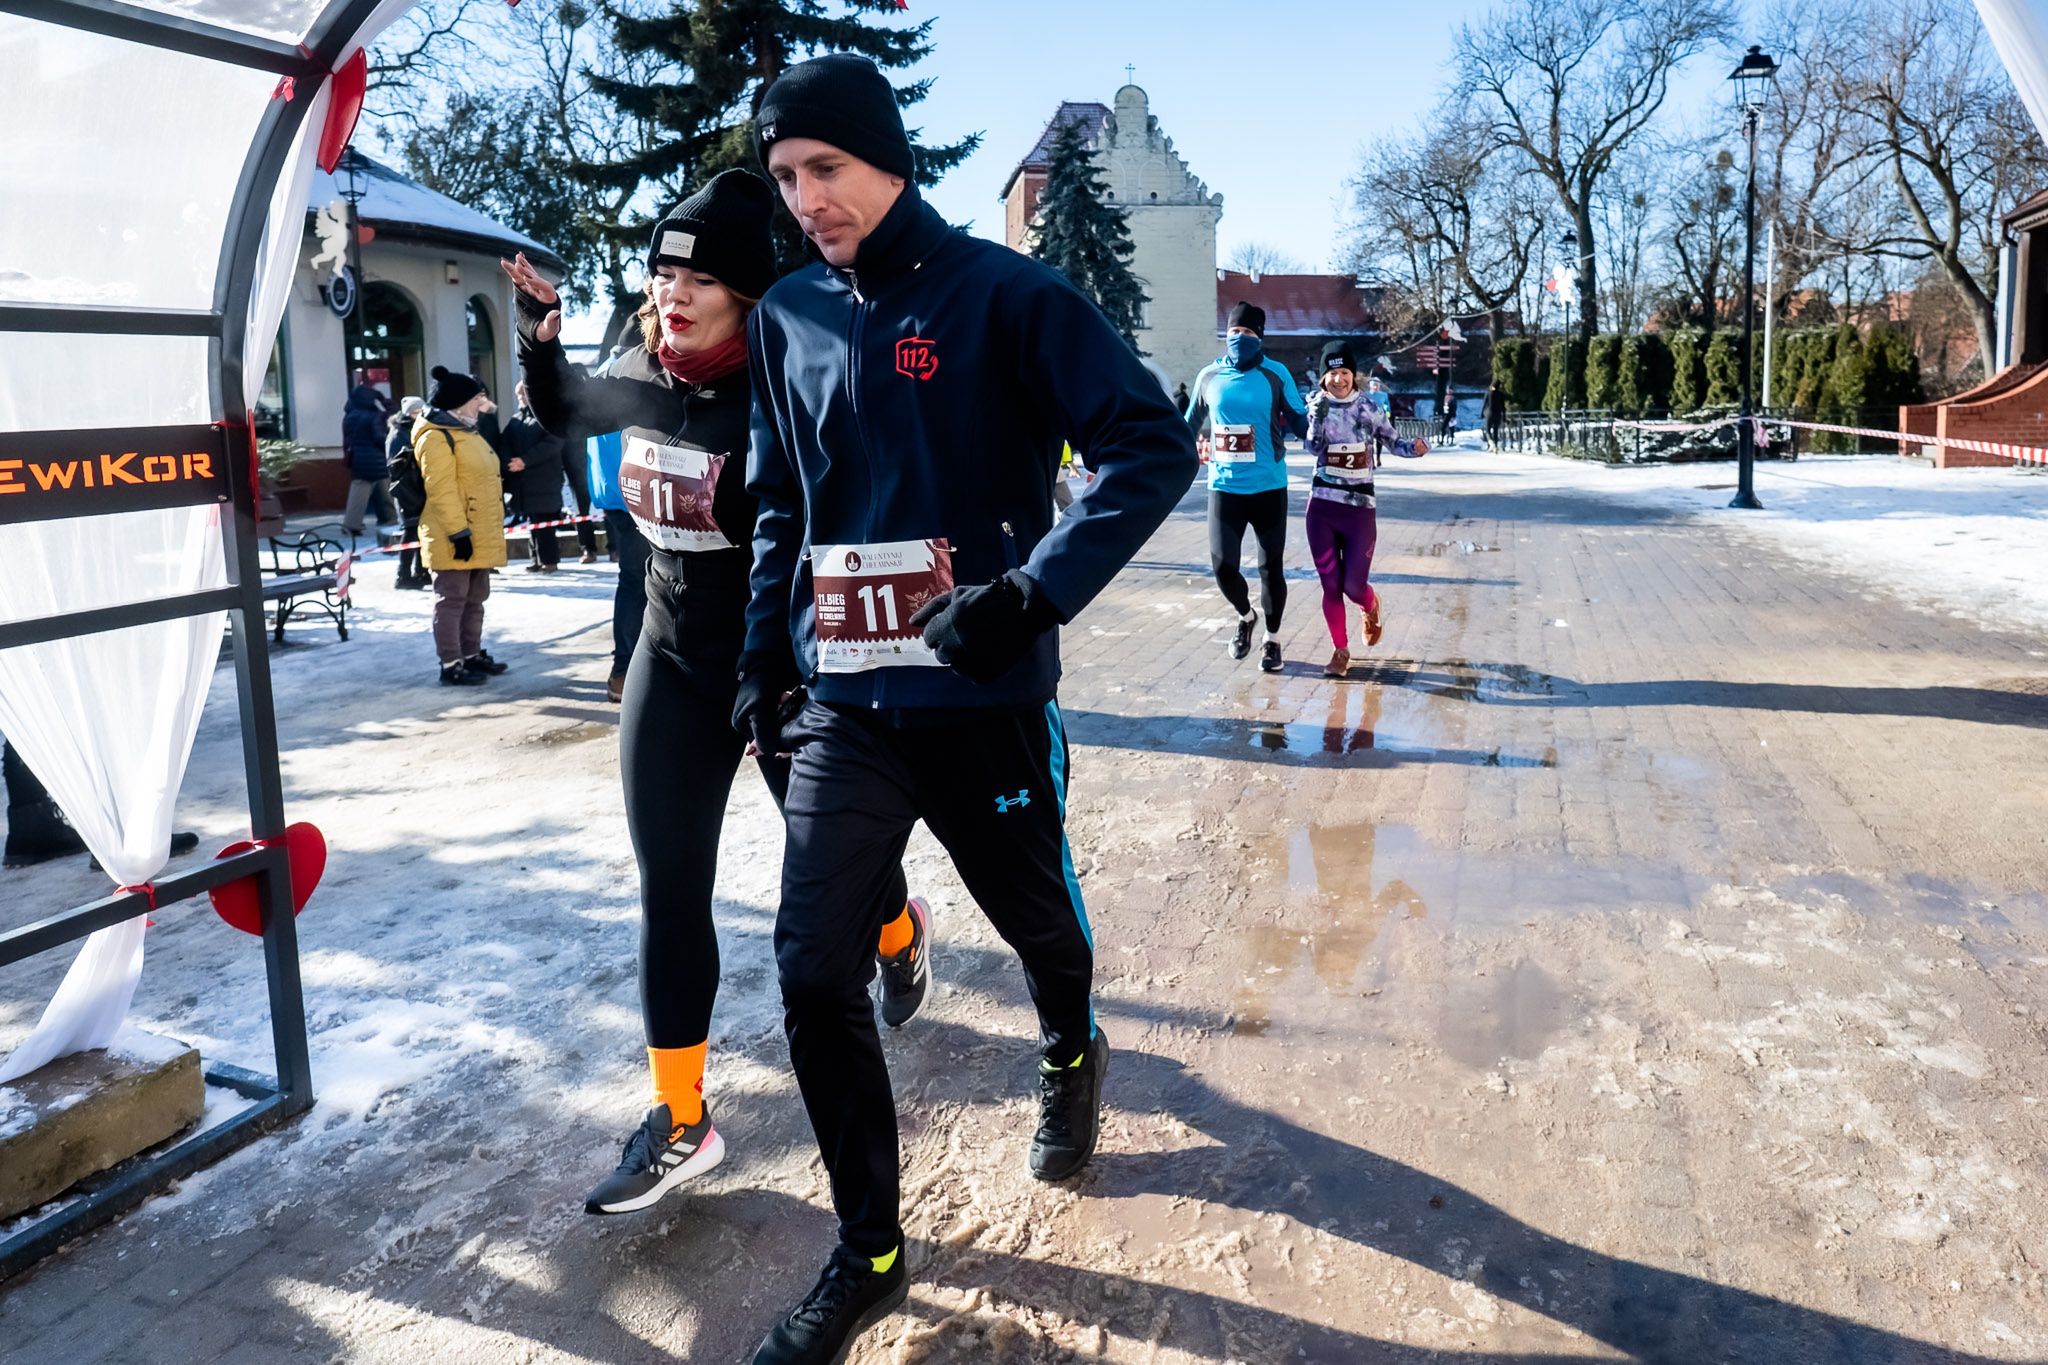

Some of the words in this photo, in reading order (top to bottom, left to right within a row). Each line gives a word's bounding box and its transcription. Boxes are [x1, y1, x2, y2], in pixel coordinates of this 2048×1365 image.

[902, 347, 929, 368] 112
[1228, 435, 1238, 451] 2
[1345, 454, 1355, 469] 2
[649, 478, 675, 521] 11
[817, 593, 846, 606] 11.BIEG
[857, 584, 899, 632] 11
